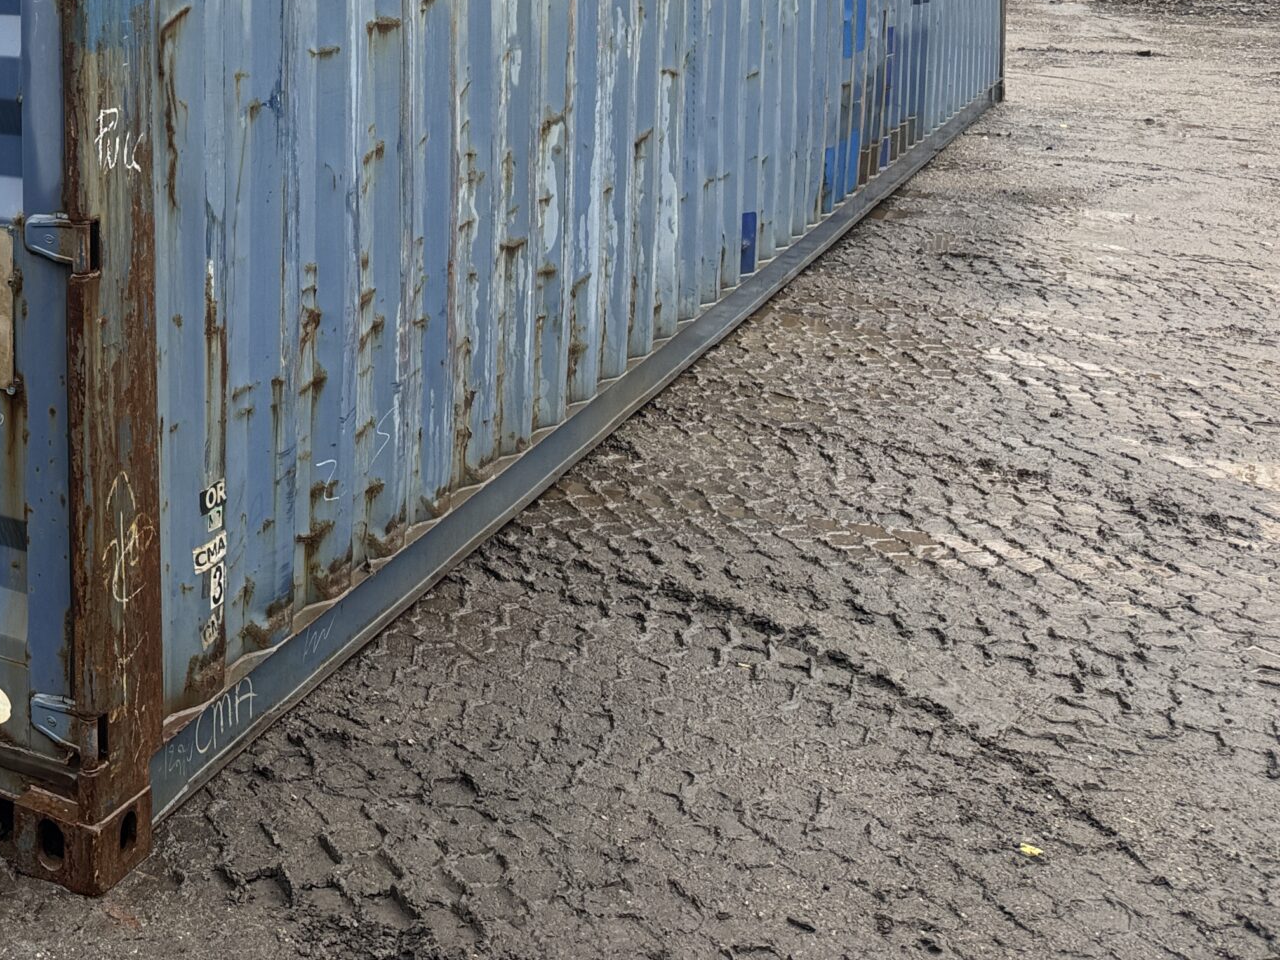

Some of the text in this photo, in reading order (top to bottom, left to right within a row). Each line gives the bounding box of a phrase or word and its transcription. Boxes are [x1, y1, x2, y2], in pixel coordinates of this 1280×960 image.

[205, 482, 227, 509] OR
[195, 536, 226, 567] CMA
[212, 565, 223, 605] 3
[195, 676, 258, 754] CMA
